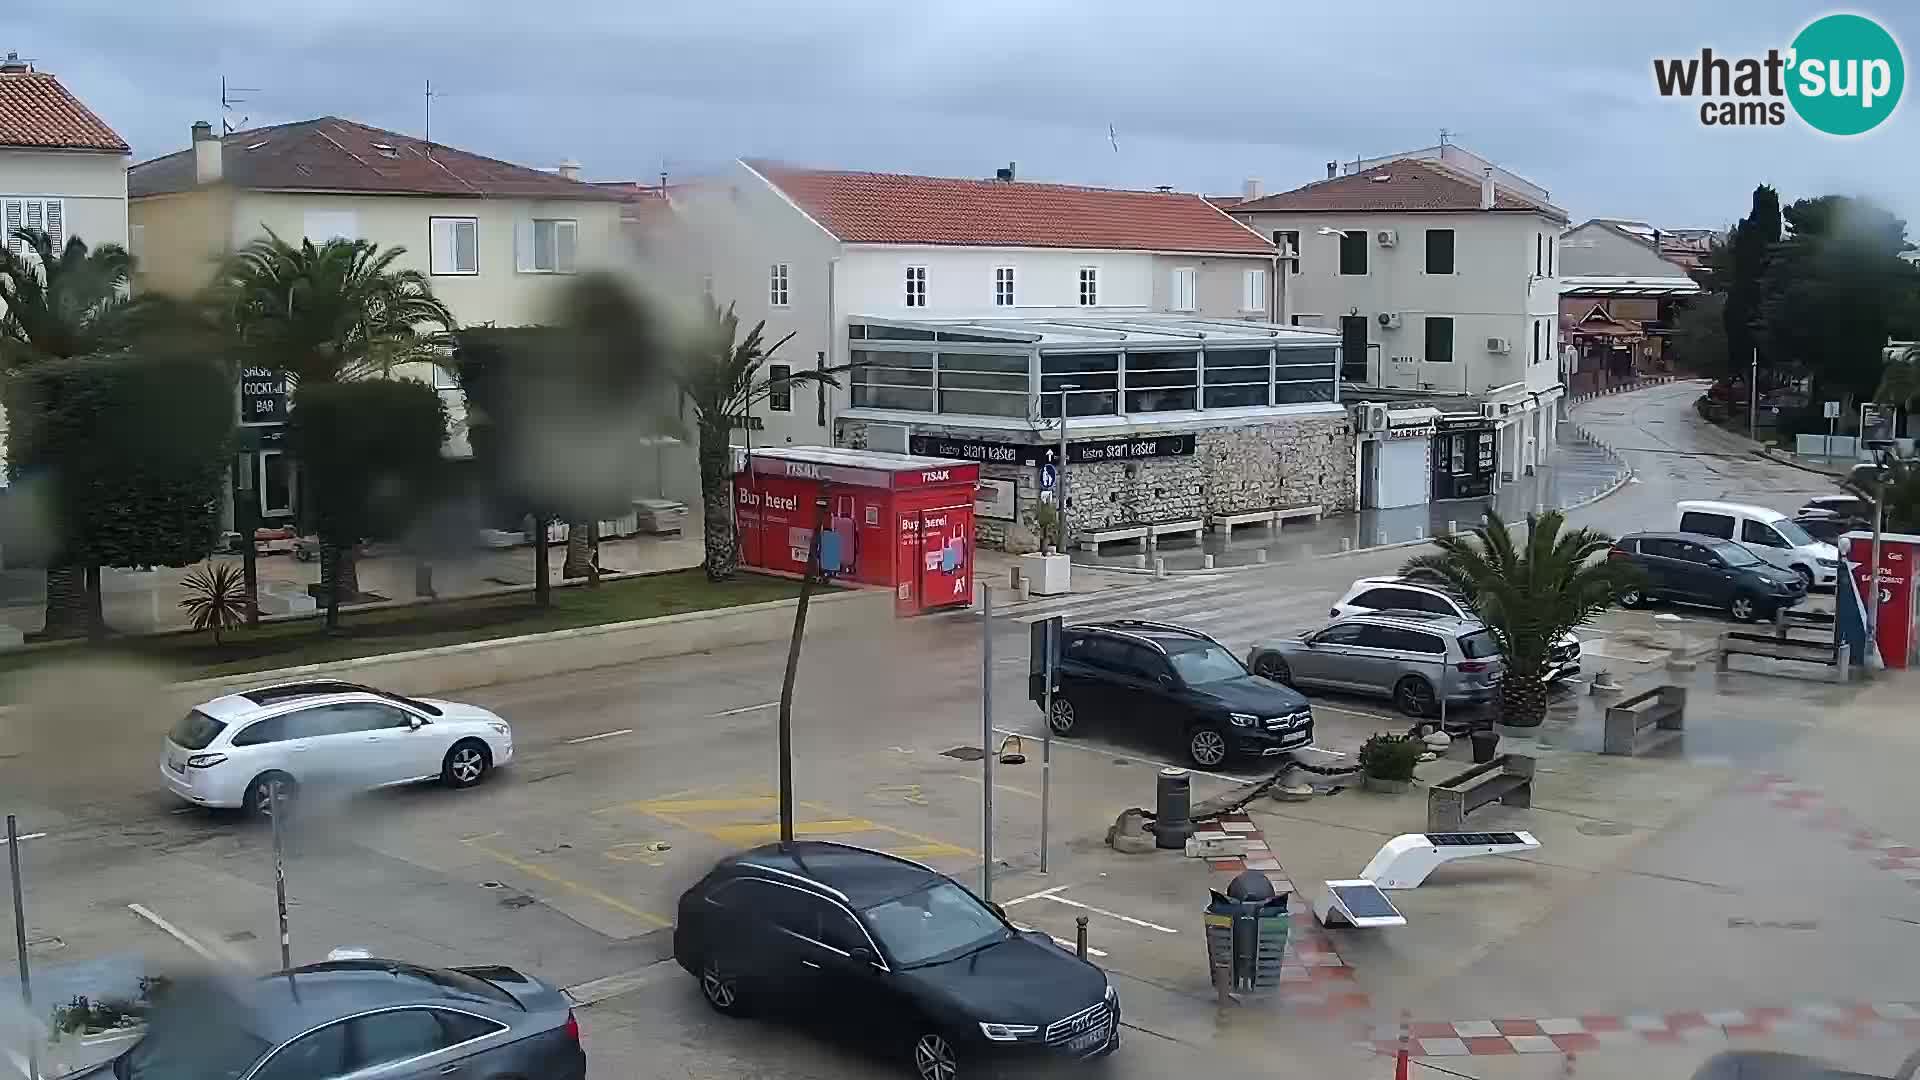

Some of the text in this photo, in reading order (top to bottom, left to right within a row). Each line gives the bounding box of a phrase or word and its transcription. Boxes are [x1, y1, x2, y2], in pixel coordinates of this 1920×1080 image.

[256, 399, 274, 413] BAR
[922, 470, 950, 482] TISAK
[739, 487, 797, 511] Buy here!
[902, 514, 947, 531] Buy here!
